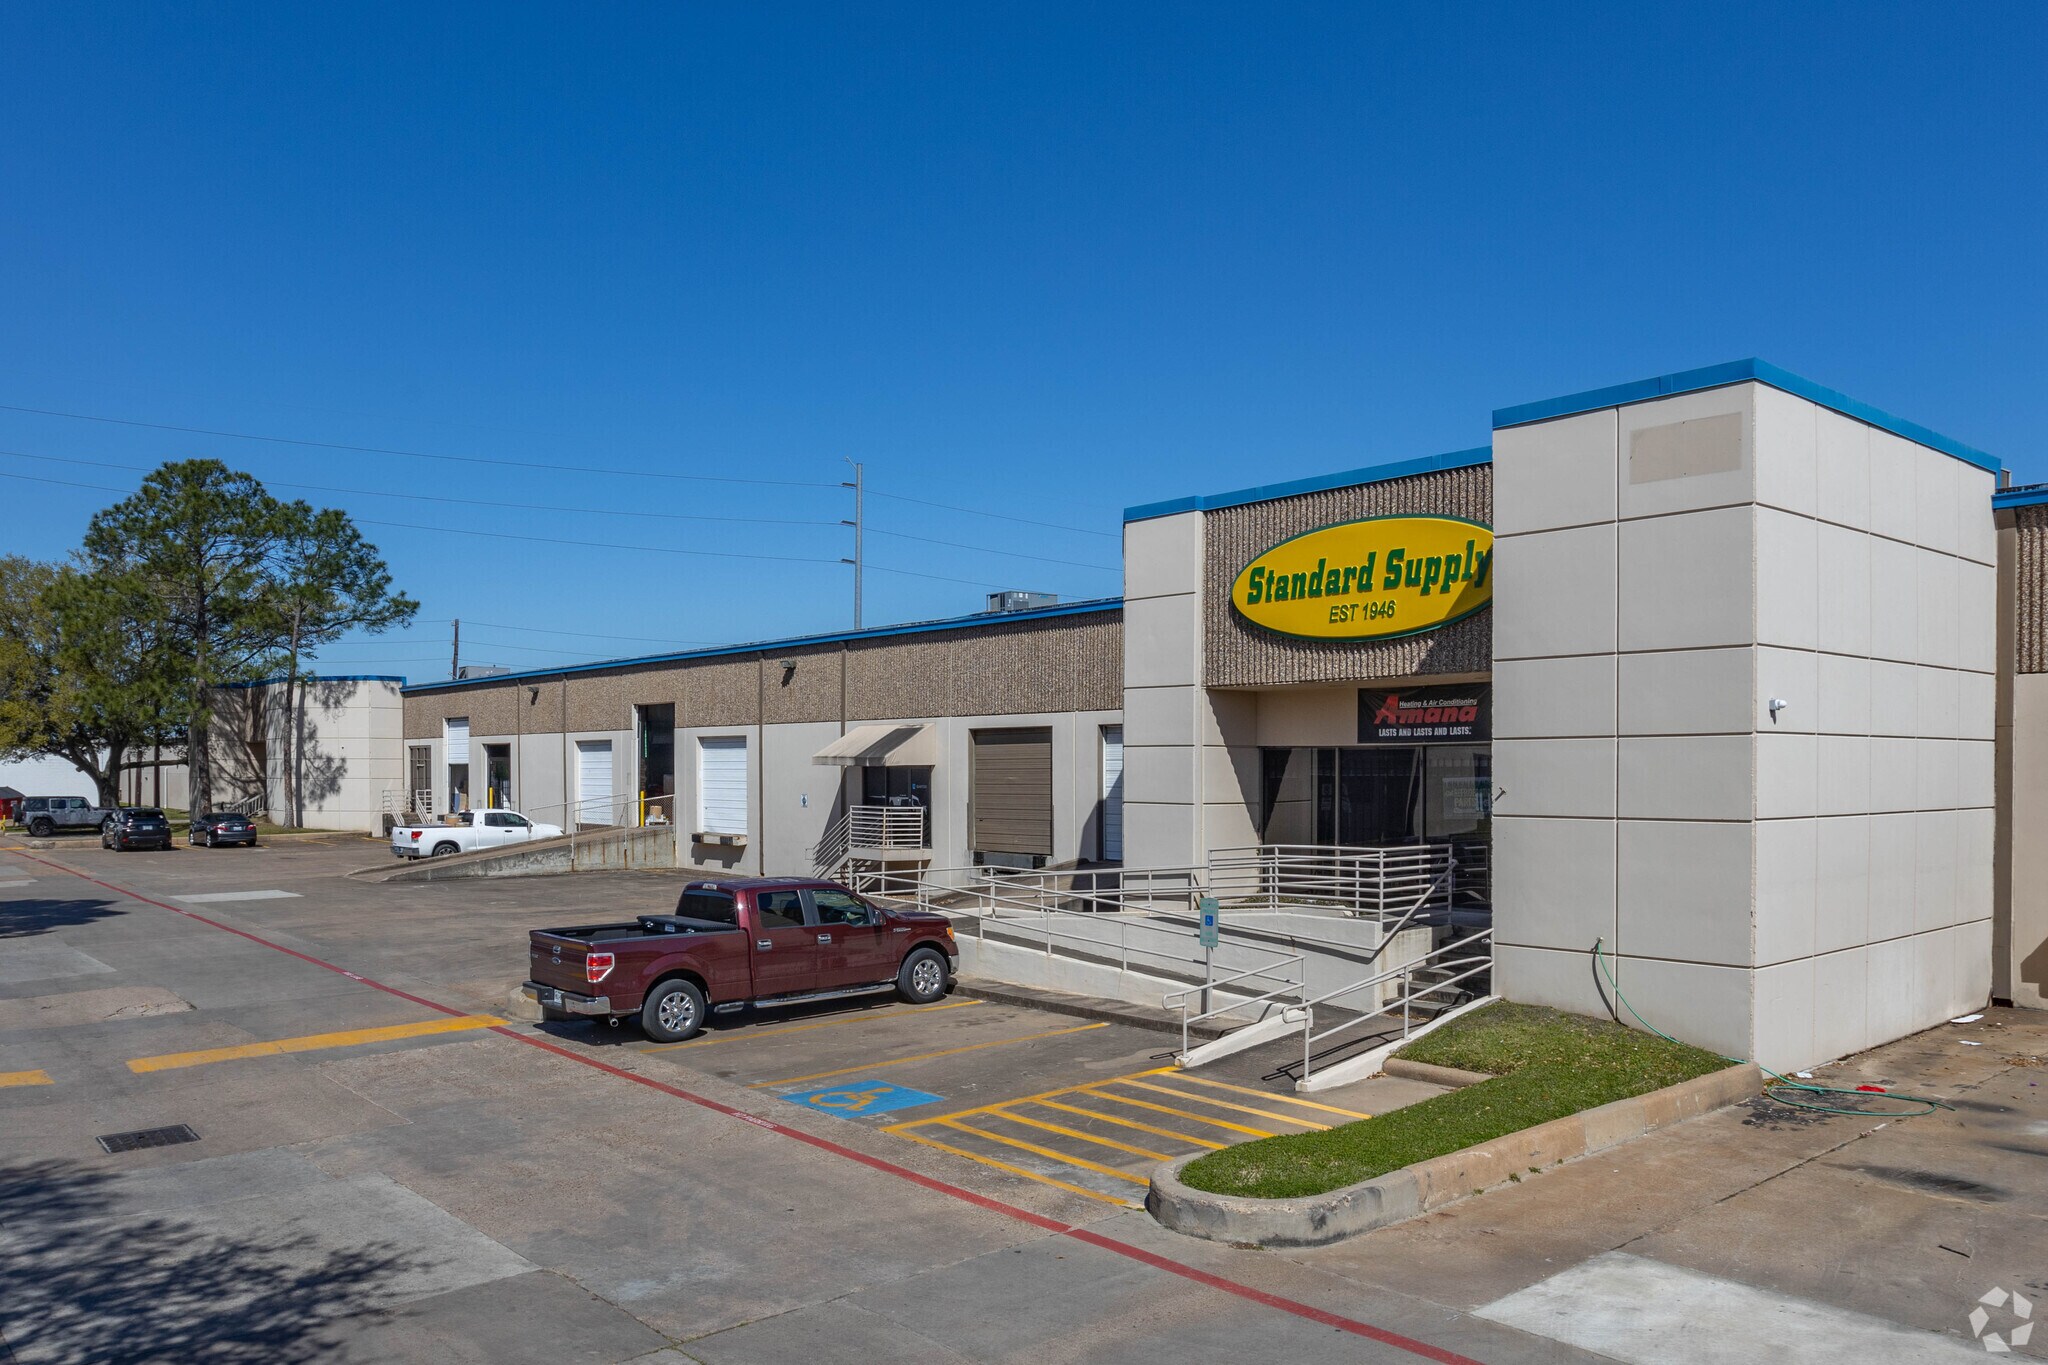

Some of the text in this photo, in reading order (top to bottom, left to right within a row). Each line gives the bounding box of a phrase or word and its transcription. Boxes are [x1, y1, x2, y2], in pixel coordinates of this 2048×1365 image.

[1247, 539, 1492, 605] Standard Supply
[1329, 600, 1396, 624] EST 1946
[1374, 694, 1478, 725] Amana
[1399, 700, 1422, 708] Heating
[1438, 698, 1478, 707] Conditioning
[1378, 728, 1397, 737] LASTS
[1398, 728, 1412, 737] AND
[1413, 727, 1433, 737] LASTS
[1434, 727, 1448, 736] AND
